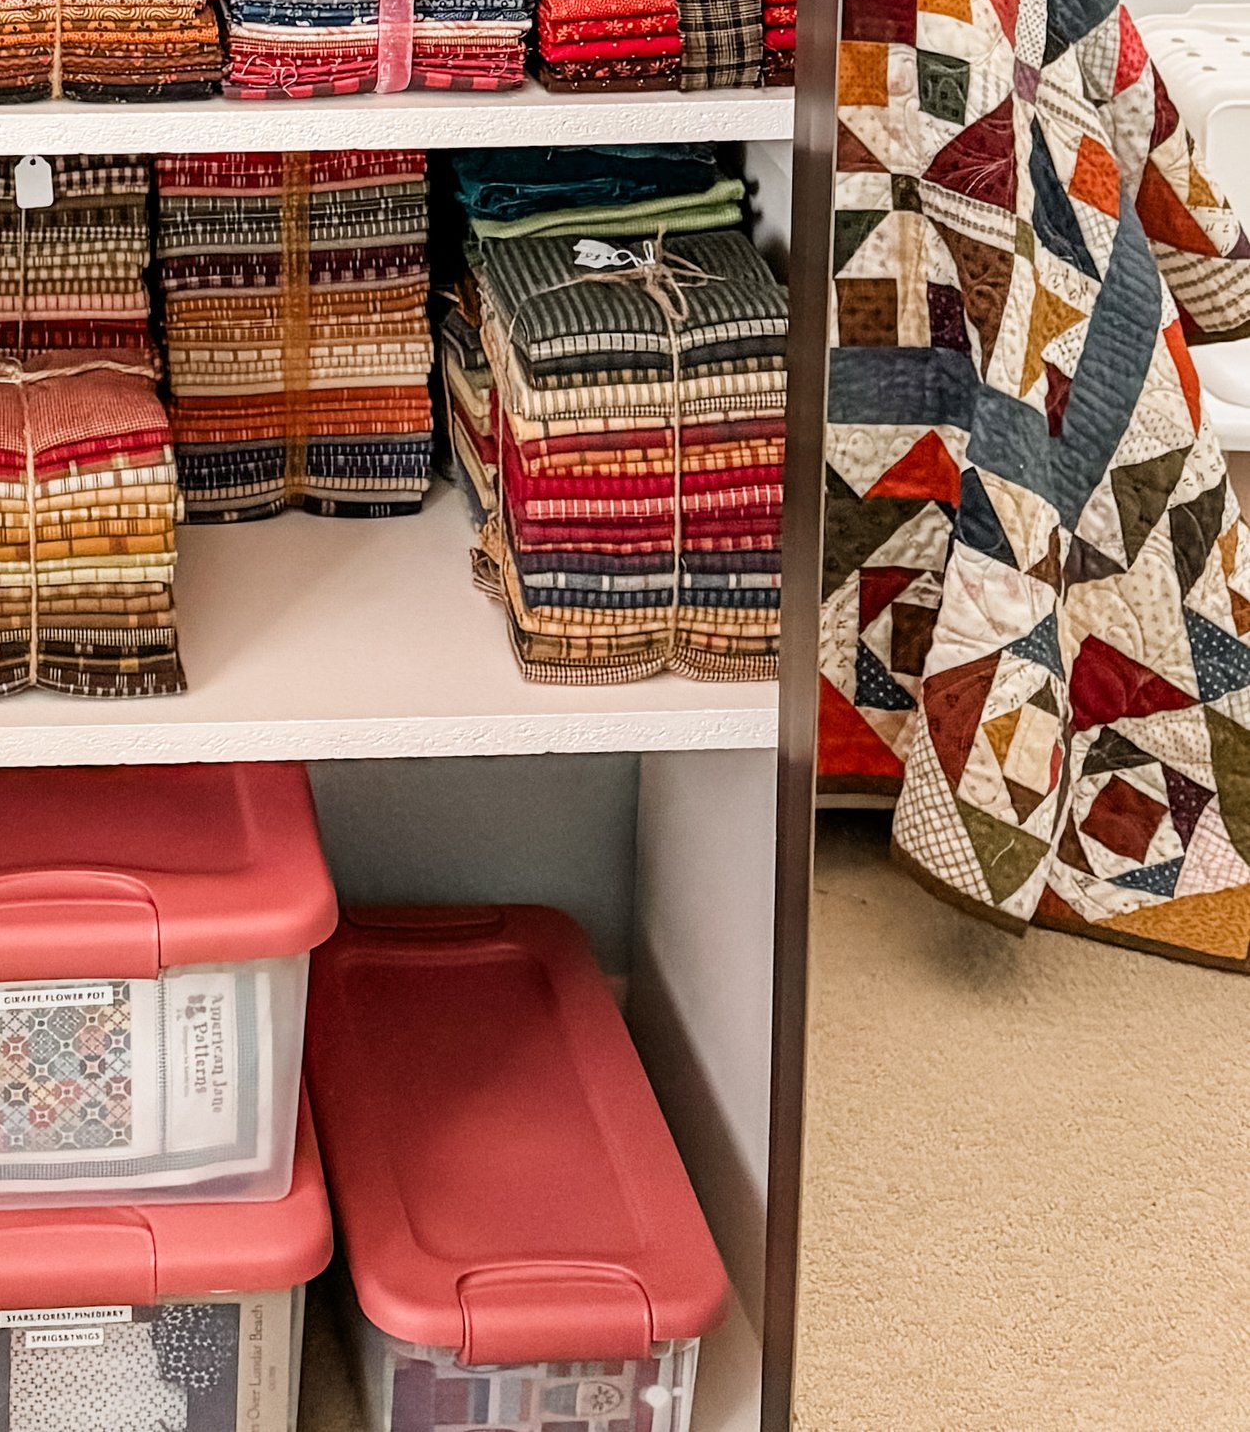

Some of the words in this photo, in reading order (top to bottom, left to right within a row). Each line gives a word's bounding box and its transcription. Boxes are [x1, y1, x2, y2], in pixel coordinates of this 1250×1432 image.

[87, 991, 105, 1000] POT
[210, 993, 224, 1076] American
[193, 1022, 209, 1094] Patterns
[211, 1080, 227, 1114] Jane
[249, 1303, 264, 1341] Beach
